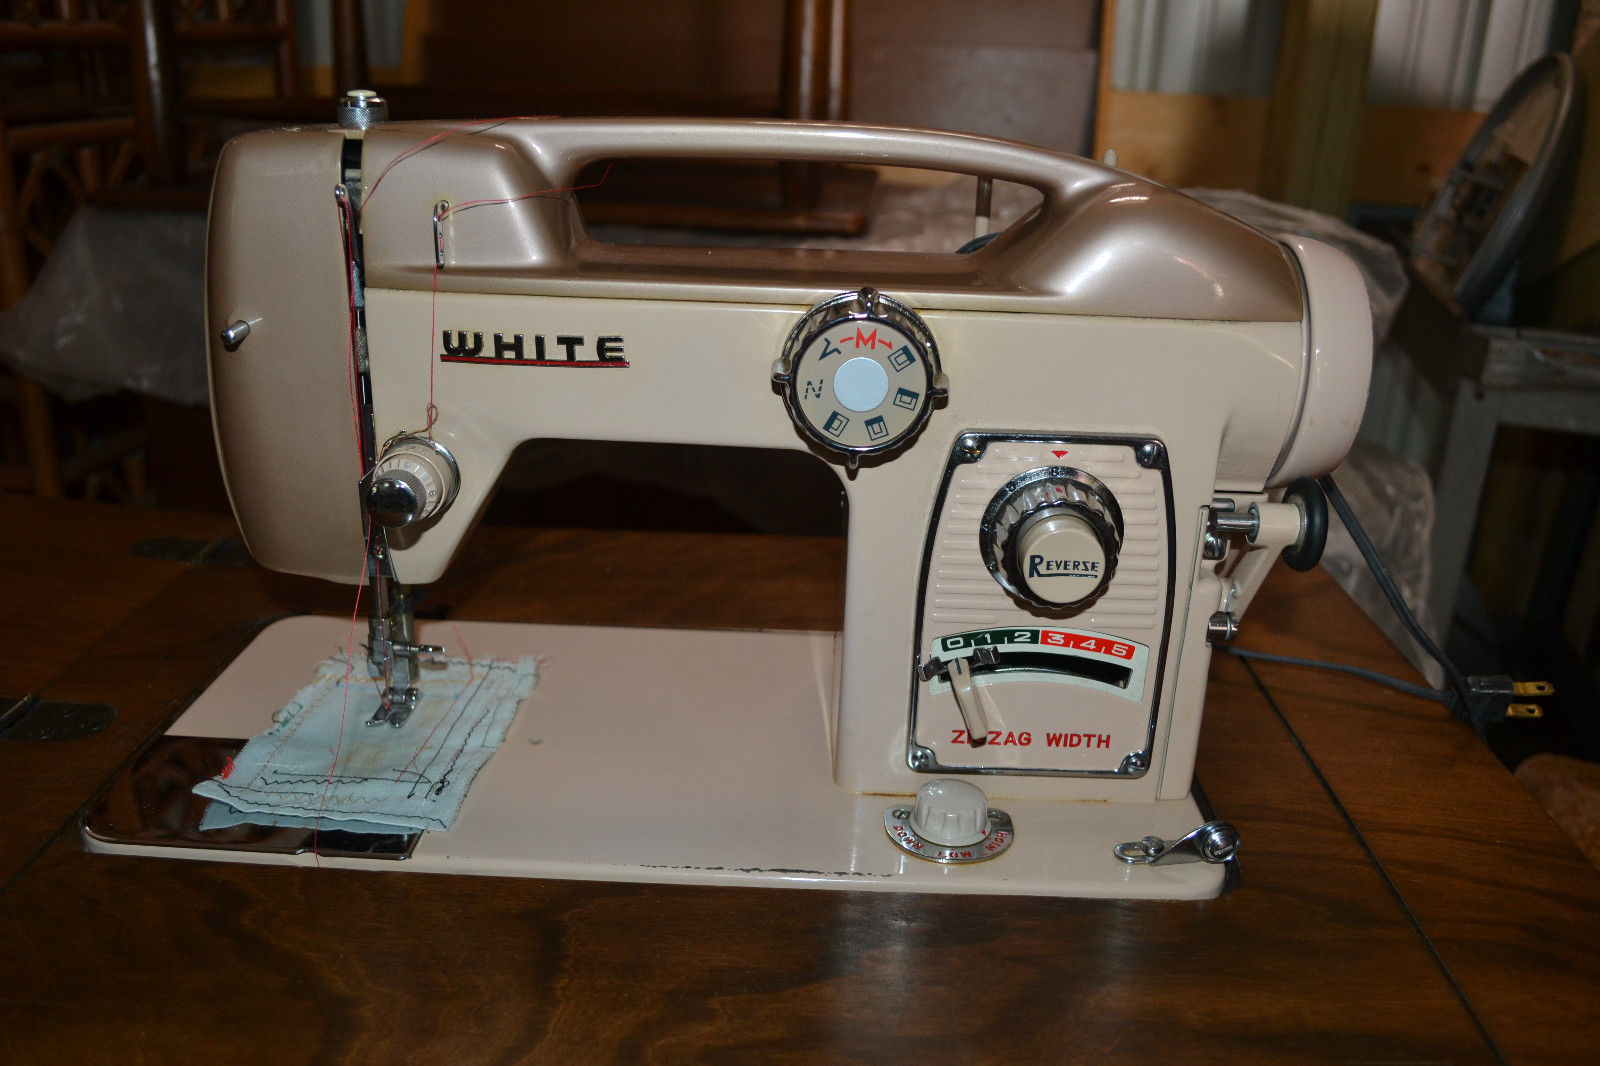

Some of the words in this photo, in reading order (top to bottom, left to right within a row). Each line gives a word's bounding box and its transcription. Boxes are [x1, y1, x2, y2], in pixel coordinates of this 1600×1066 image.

[442, 329, 625, 363] WHITE
[946, 636, 964, 649] 0
[984, 632, 992, 644] 1
[1013, 631, 1031, 642] 2
[1047, 632, 1065, 645] 3
[1080, 639, 1097, 650] 4
[1111, 643, 1129, 656] 5
[951, 729, 1032, 746] ZIZAG
[1046, 733, 1111, 749] WIDTH
[893, 825, 924, 850] DOWN
[985, 831, 1008, 852] HIGH
